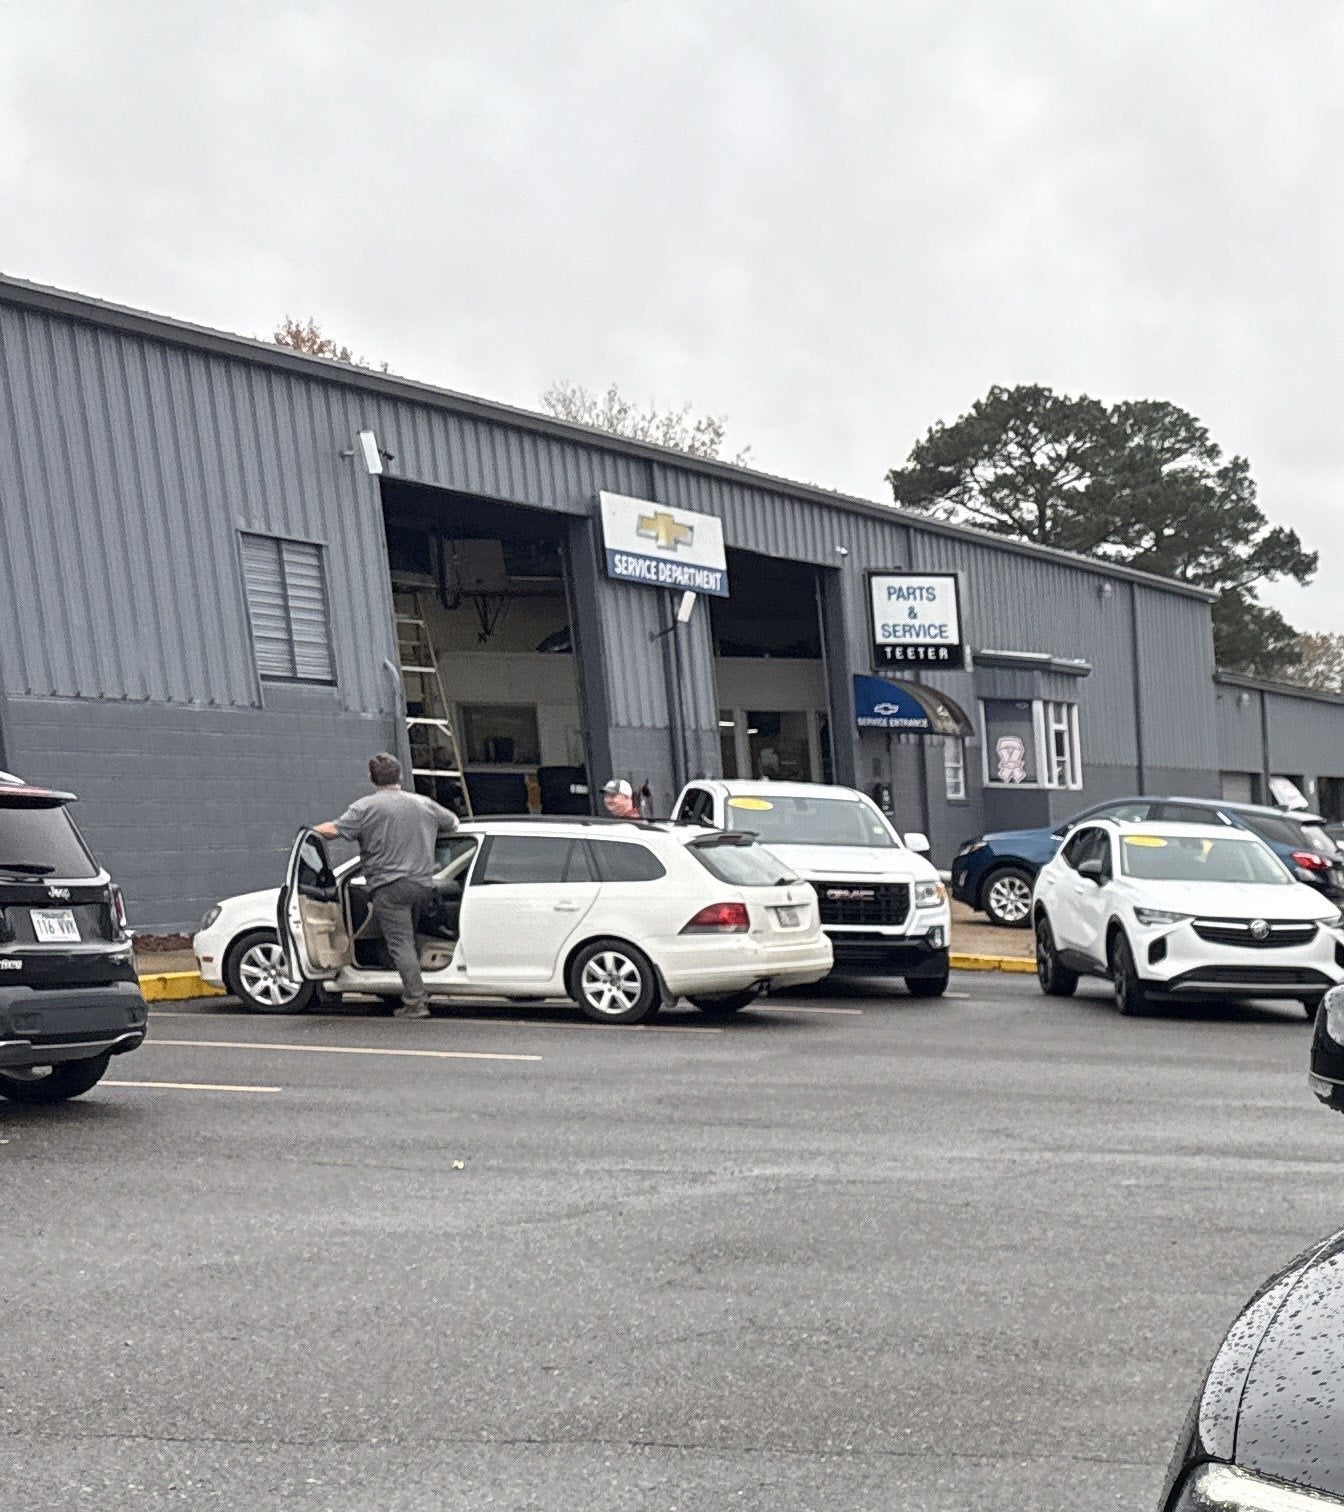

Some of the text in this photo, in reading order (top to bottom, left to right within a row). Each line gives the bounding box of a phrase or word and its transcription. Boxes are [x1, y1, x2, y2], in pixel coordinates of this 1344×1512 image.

[614, 554, 721, 591] SERVICE DEPARTMENT
[887, 586, 936, 601] PARTS
[908, 606, 917, 620] &
[881, 623, 949, 639] SERVICE
[884, 646, 949, 660] TEETER
